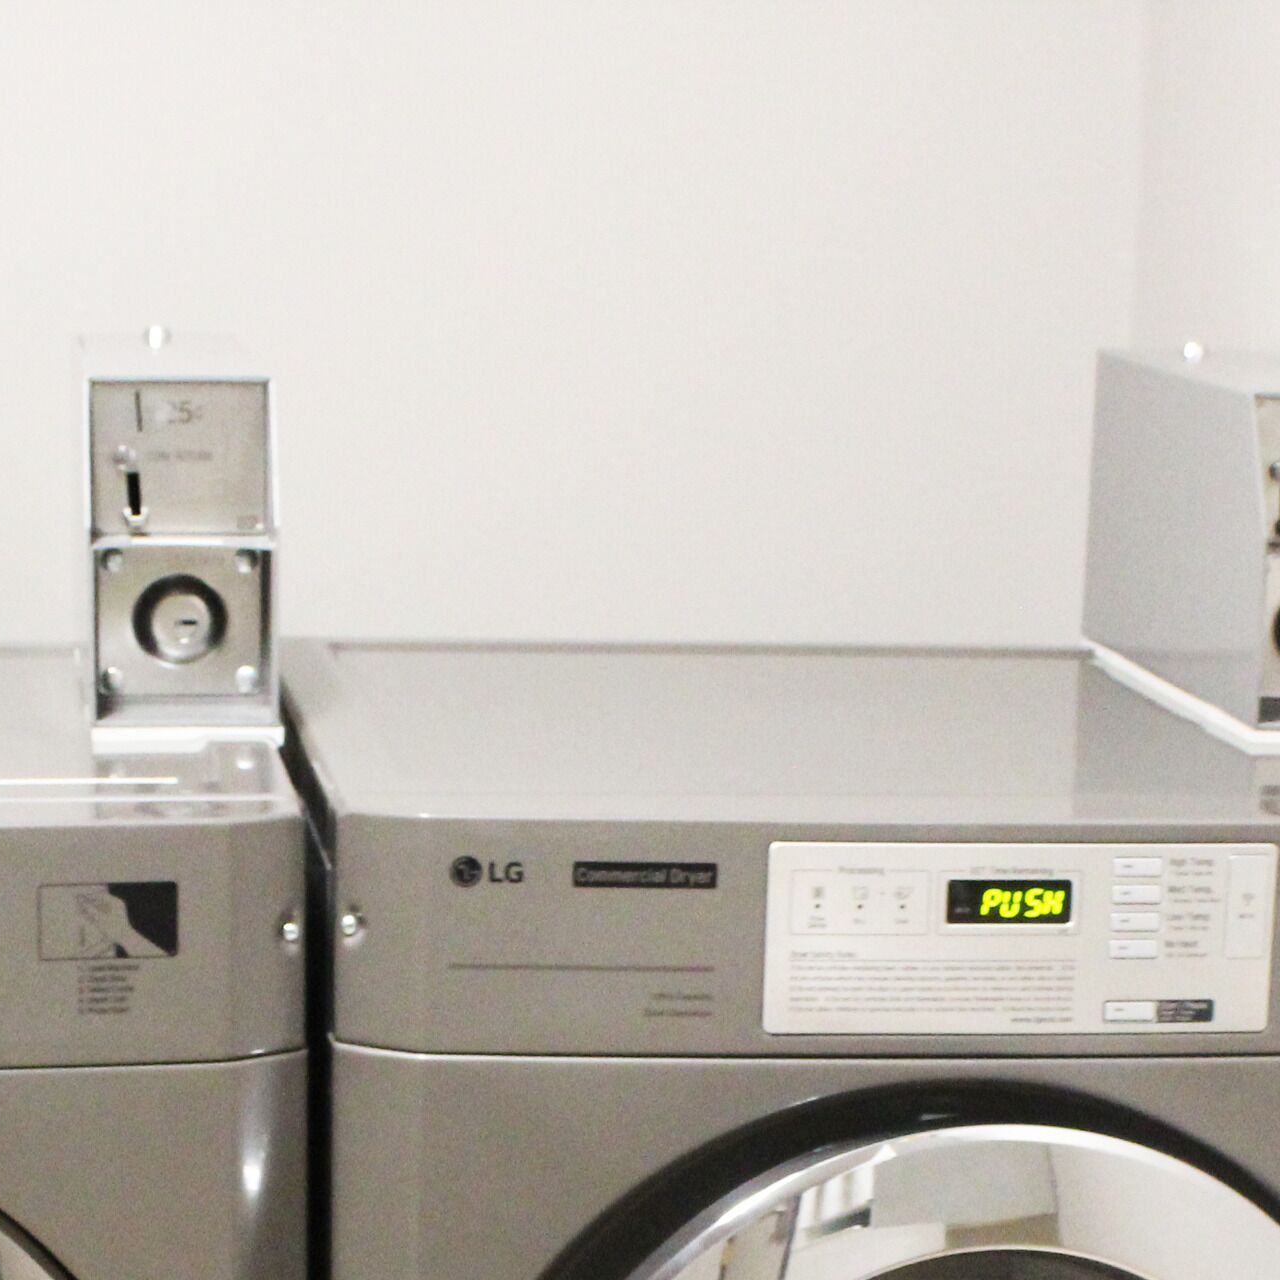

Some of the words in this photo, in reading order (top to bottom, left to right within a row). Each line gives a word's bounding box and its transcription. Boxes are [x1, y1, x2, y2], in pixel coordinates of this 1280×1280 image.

[488, 861, 524, 883] LG
[575, 867, 666, 884] Commercial
[670, 867, 714, 886] Dryer
[980, 888, 1066, 918] PUSH
